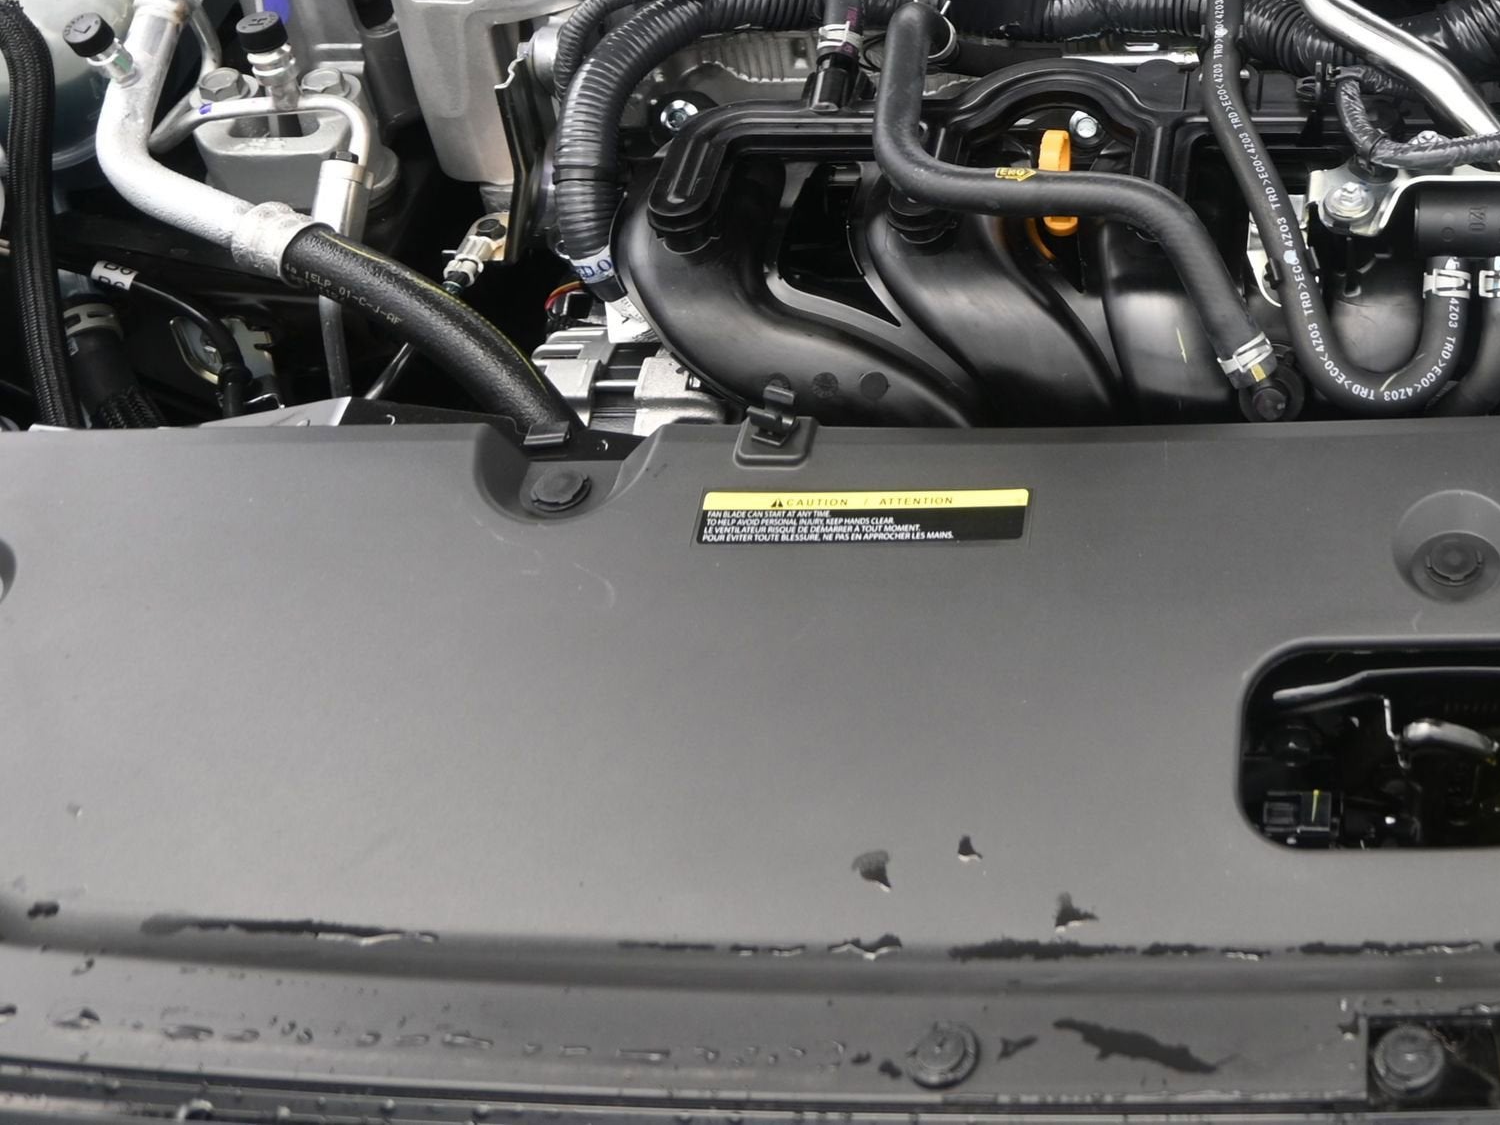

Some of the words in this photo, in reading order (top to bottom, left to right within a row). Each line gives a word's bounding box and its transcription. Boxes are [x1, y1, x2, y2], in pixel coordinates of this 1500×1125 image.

[787, 498, 848, 507] CAUTION
[879, 496, 953, 506] ATTENTION
[786, 510, 797, 518] AT
[797, 510, 813, 518] ANY
[707, 518, 717, 526] TO
[718, 518, 736, 526] HELP
[736, 518, 760, 526] AVOID
[760, 518, 797, 526] PERSONAL
[844, 517, 870, 525] HANDS
[703, 526, 713, 534] LE
[714, 525, 766, 534] VENTILATEUR
[767, 525, 796, 534] RISQUE
[797, 525, 809, 533] DE
[861, 524, 883, 533] TOUT
[702, 534, 725, 542] POUR
[754, 533, 780, 542] TOUTE
[822, 532, 833, 541] NE
[834, 532, 849, 541] PAS
[850, 532, 862, 541] EN
[862, 532, 911, 541] APPROCHER
[911, 531, 926, 540] LES
[926, 530, 954, 540] MAINS.
